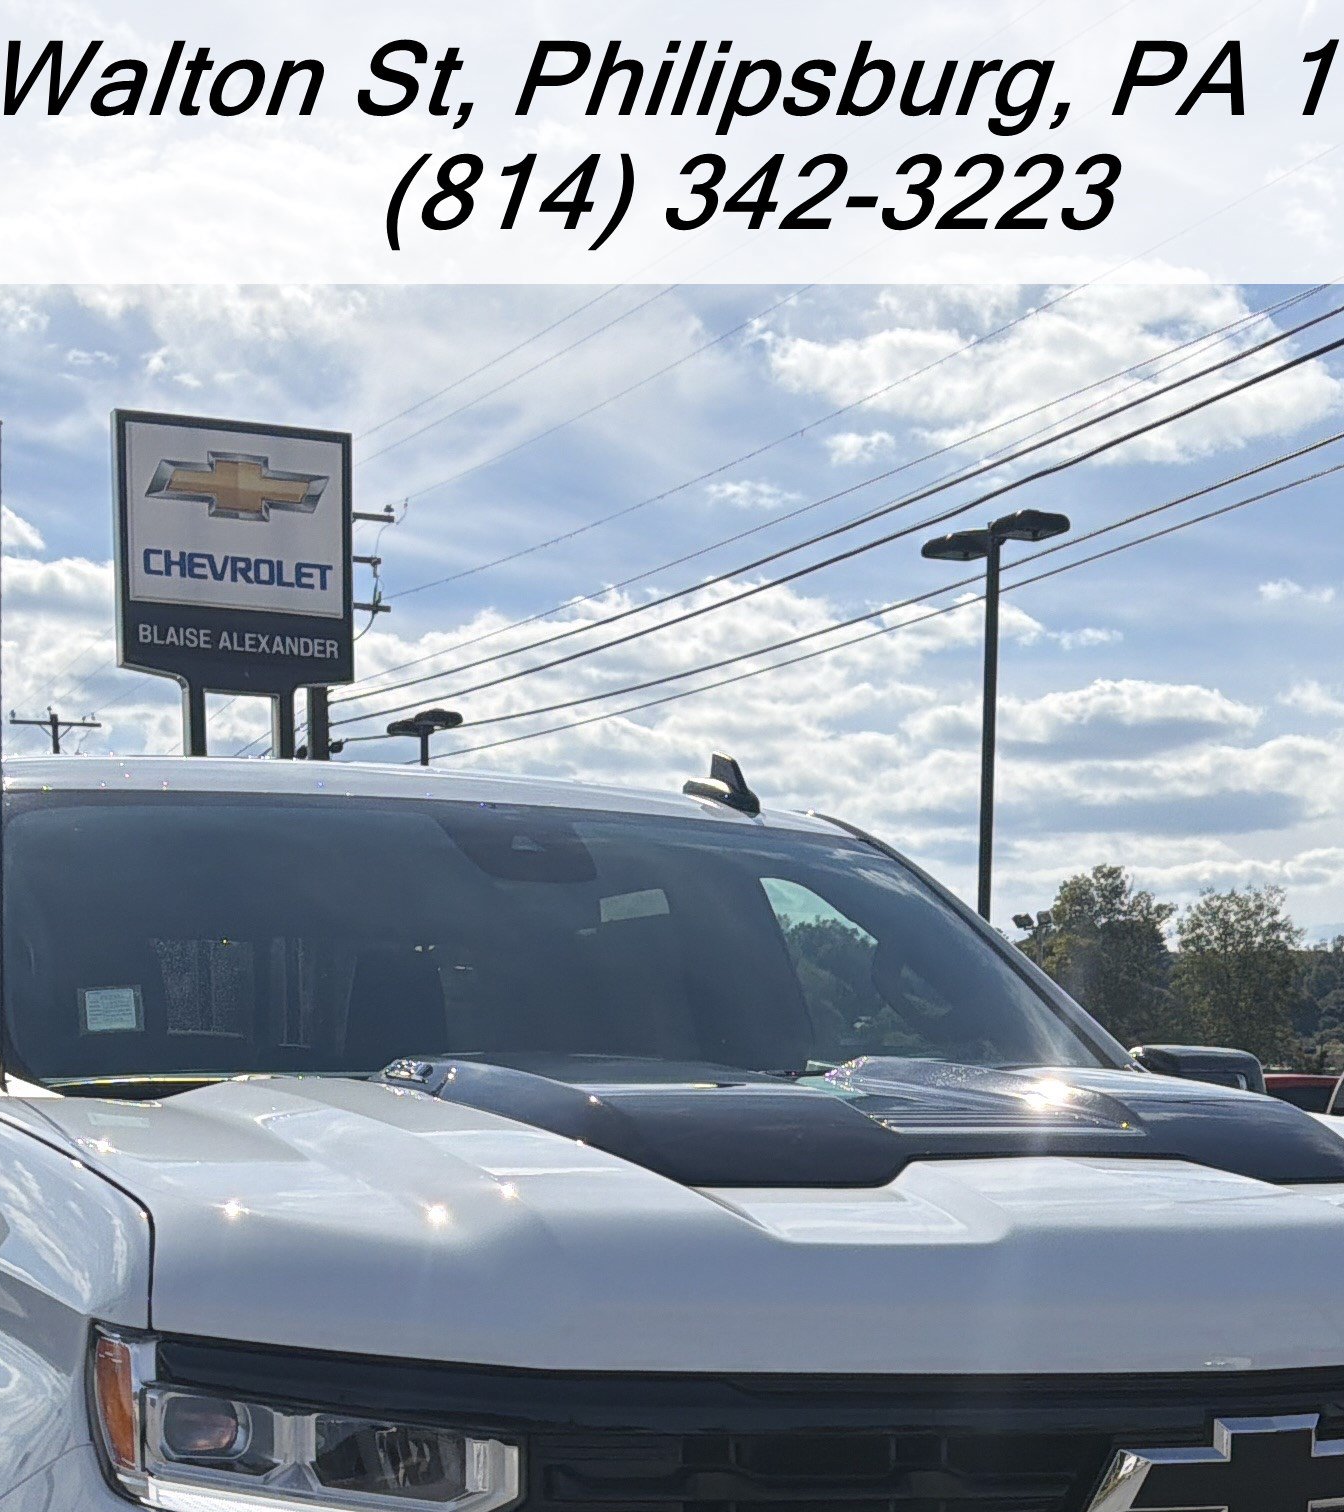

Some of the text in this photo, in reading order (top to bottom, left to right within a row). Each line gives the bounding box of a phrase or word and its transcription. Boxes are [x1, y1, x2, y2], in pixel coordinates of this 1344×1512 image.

[143, 548, 333, 590] CHEVROLET
[138, 623, 339, 659] BLAISE ALEXANDER
